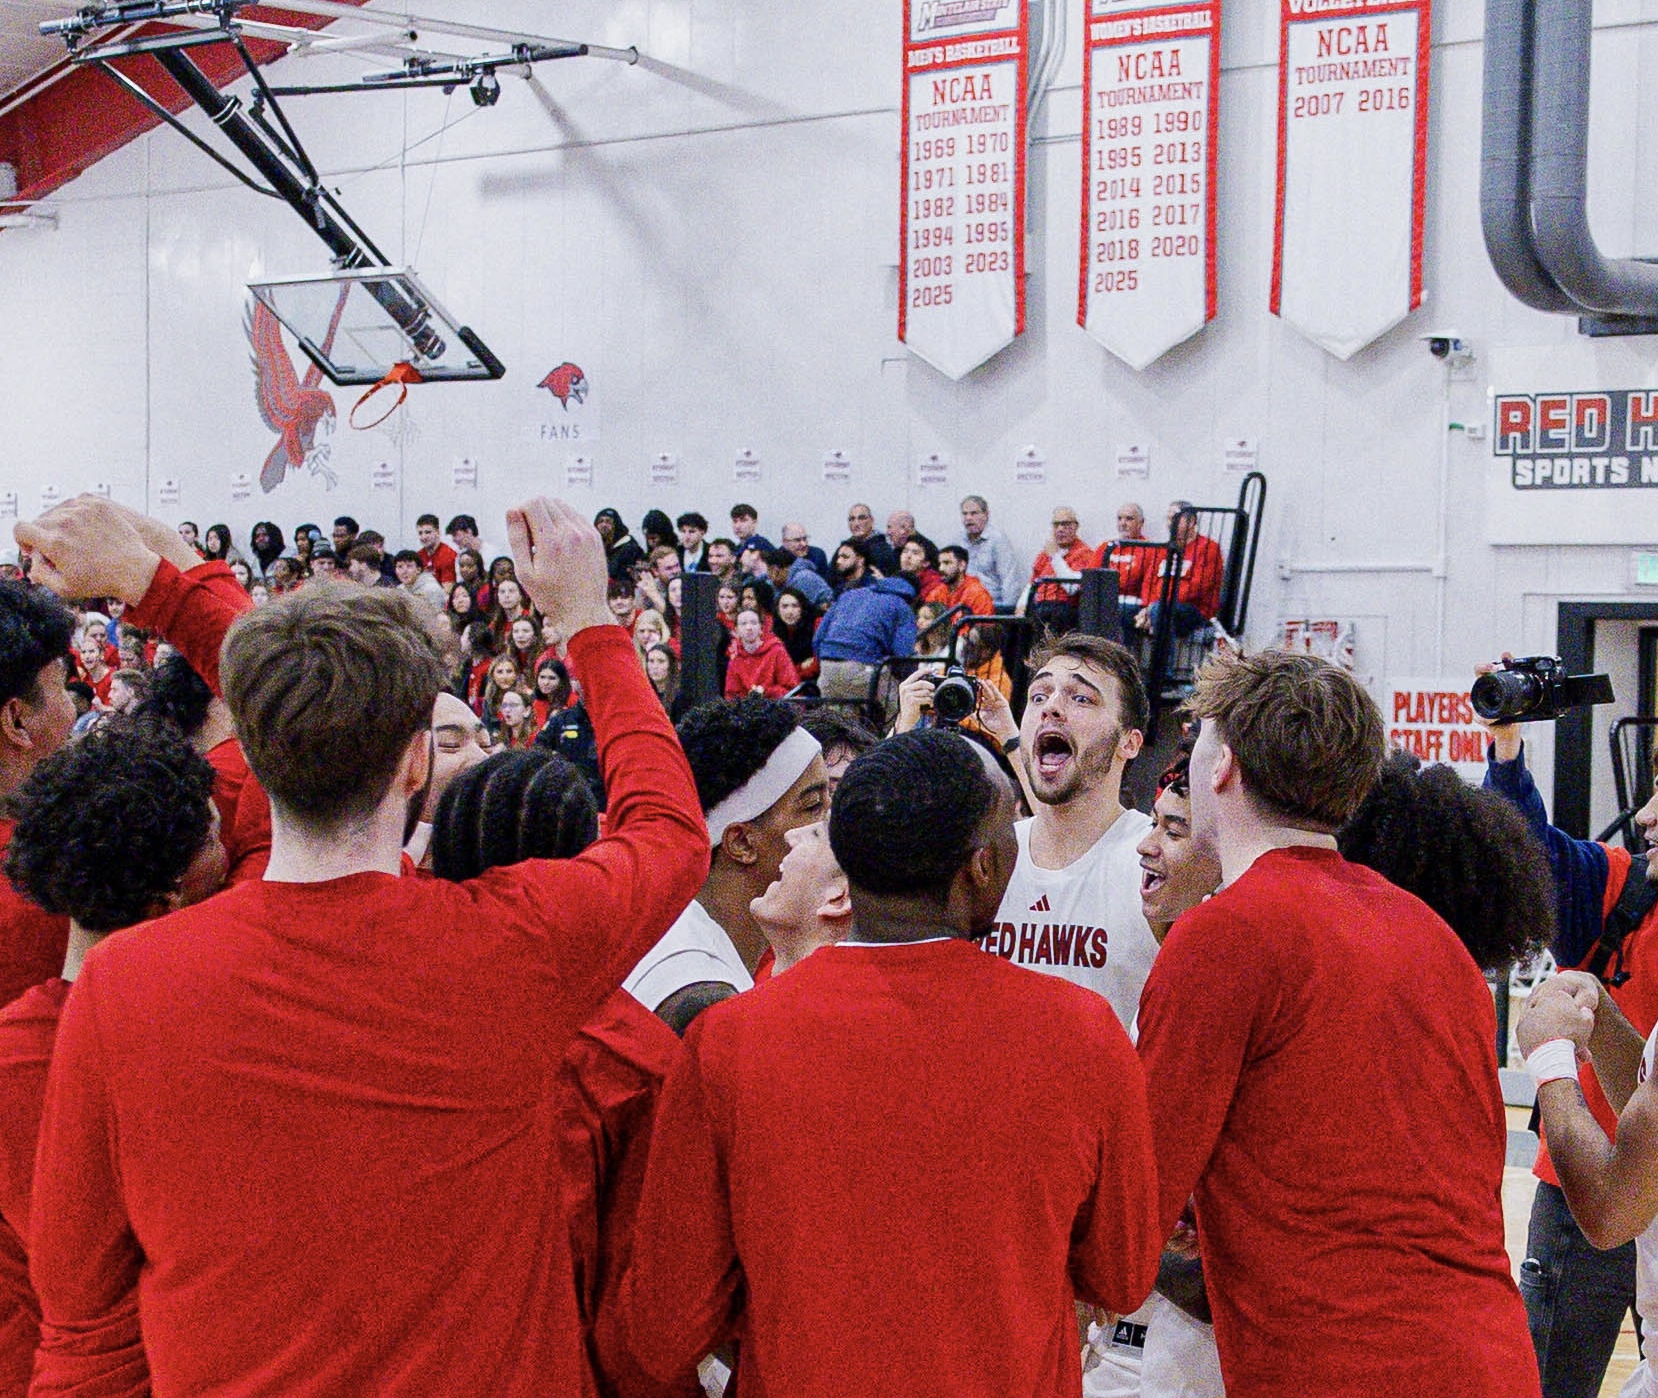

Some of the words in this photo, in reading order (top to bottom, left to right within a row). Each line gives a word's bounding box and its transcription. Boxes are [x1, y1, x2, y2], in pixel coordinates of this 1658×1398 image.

[1317, 23, 1389, 57] NCAA
[1117, 49, 1181, 82] NCAA
[1295, 57, 1411, 85] TOURNAMENT
[932, 74, 992, 106] NCAA
[1097, 81, 1203, 108] TOURNAMENT
[1294, 92, 1344, 118] 2007
[1358, 87, 1409, 111] 2016
[916, 105, 1009, 131] TOURNAMENT
[1097, 115, 1142, 140] 1989
[1153, 110, 1201, 134] 1990
[914, 137, 955, 161] 1969
[966, 132, 1008, 155] 1970
[1097, 146, 1142, 170] 1995
[1153, 142, 1201, 165] 2013
[913, 167, 955, 191] 1971
[966, 162, 1008, 185] 1981
[1096, 177, 1141, 201] 2014
[1152, 173, 1200, 196] 2015
[913, 197, 954, 220] 1982
[965, 192, 1008, 214] 1984
[1096, 208, 1140, 232] 2016
[1152, 203, 1200, 226] 2017
[913, 226, 953, 249] 1994
[965, 221, 1008, 244] 1995
[1096, 238, 1139, 263] 2018
[1151, 235, 1199, 257] 2020
[913, 255, 953, 278] 2003
[965, 251, 1009, 274] 2023
[1095, 270, 1138, 292] 2025
[912, 284, 953, 308] 2025
[540, 424, 581, 440] FANS
[1496, 395, 1611, 454] RED
[1515, 455, 1629, 485] SPORTS
[1394, 691, 1474, 725] PLAYERS
[979, 921, 1017, 961] ED
[1018, 922, 1109, 969] HAWKS
